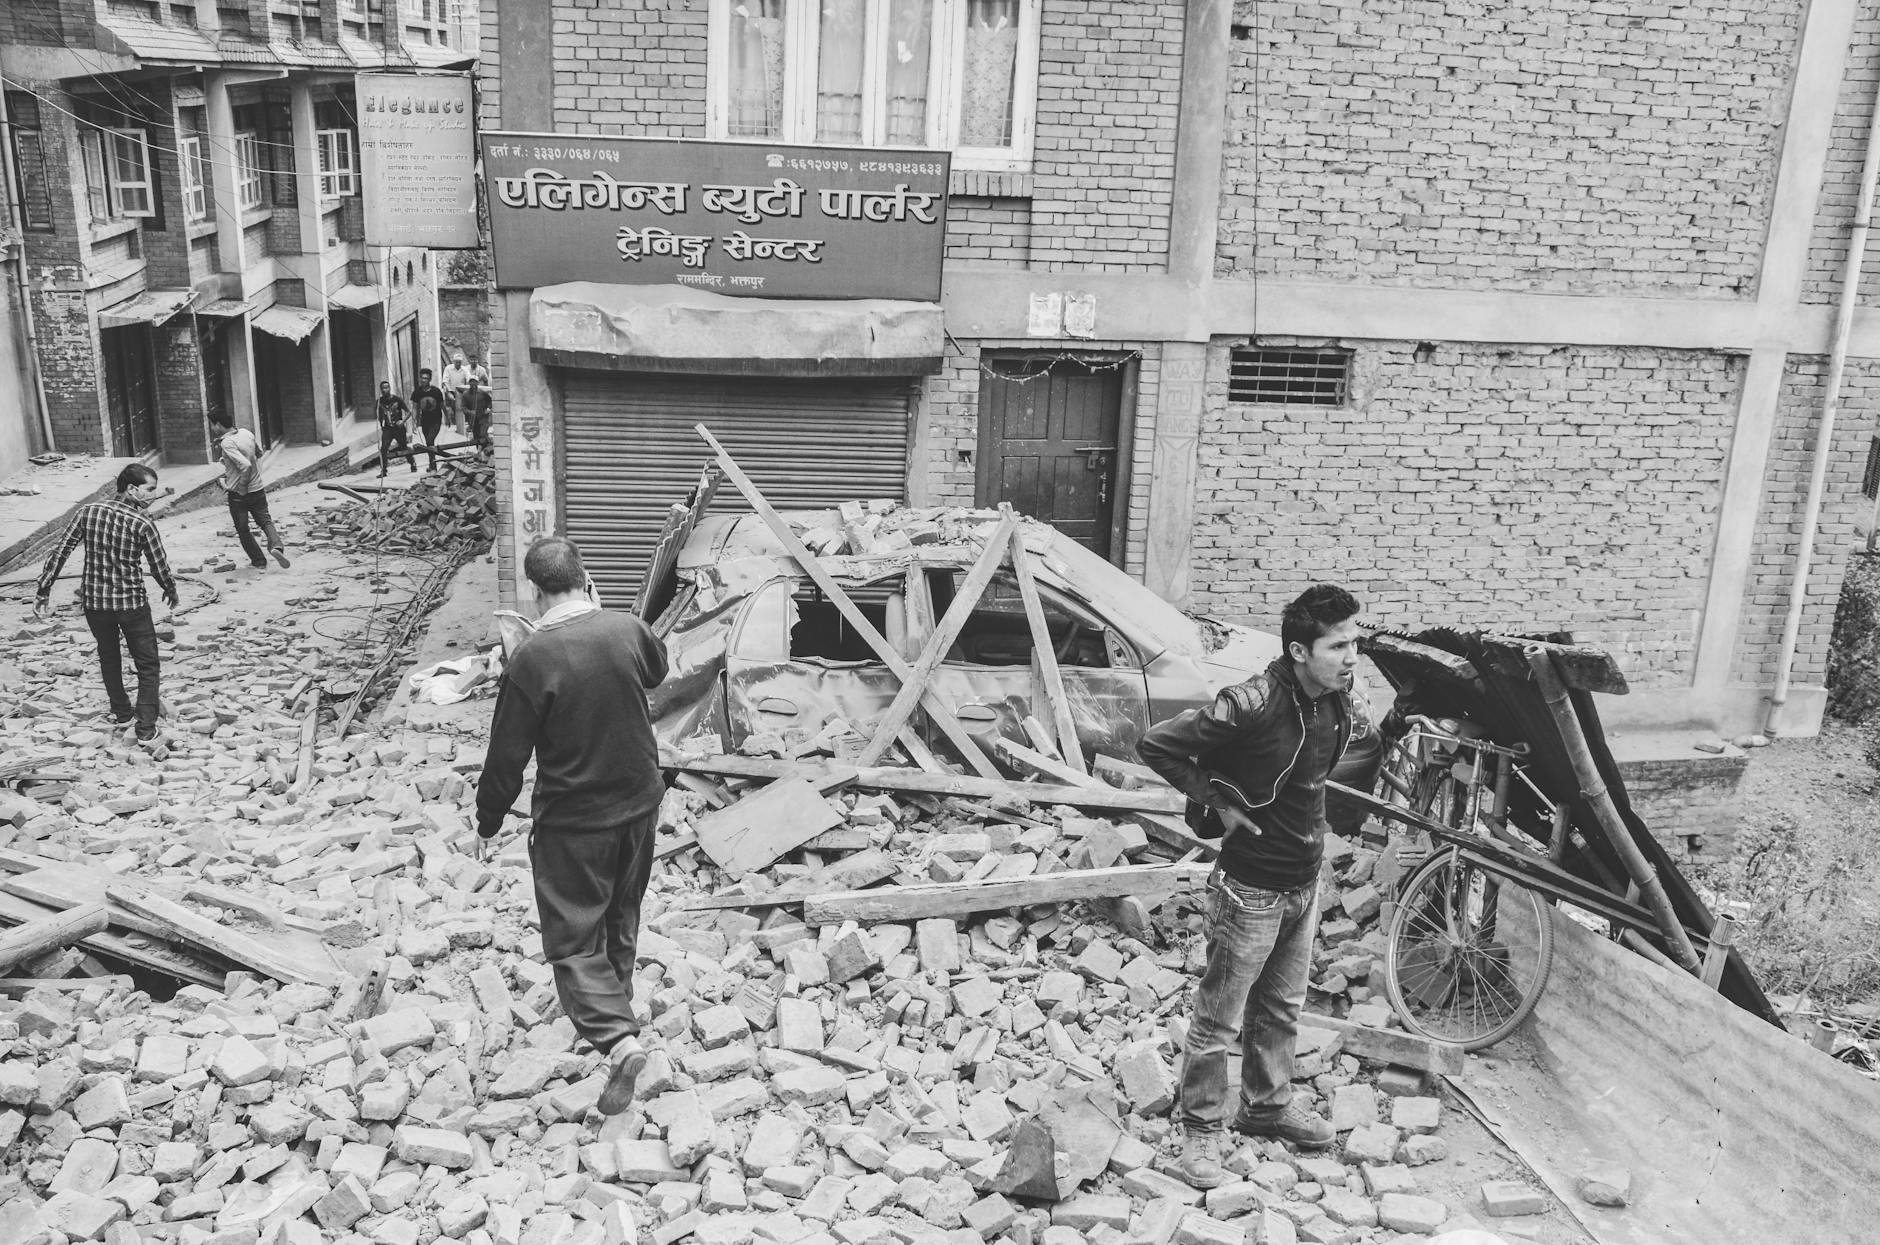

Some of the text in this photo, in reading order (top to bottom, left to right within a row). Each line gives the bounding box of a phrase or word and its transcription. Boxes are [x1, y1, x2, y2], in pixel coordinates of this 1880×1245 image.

[494, 167, 942, 224] एलिगेन्स ब्युटी पार्लर
[722, 230, 825, 263] सेन्टर
[730, 275, 766, 290] भक्तपुर
